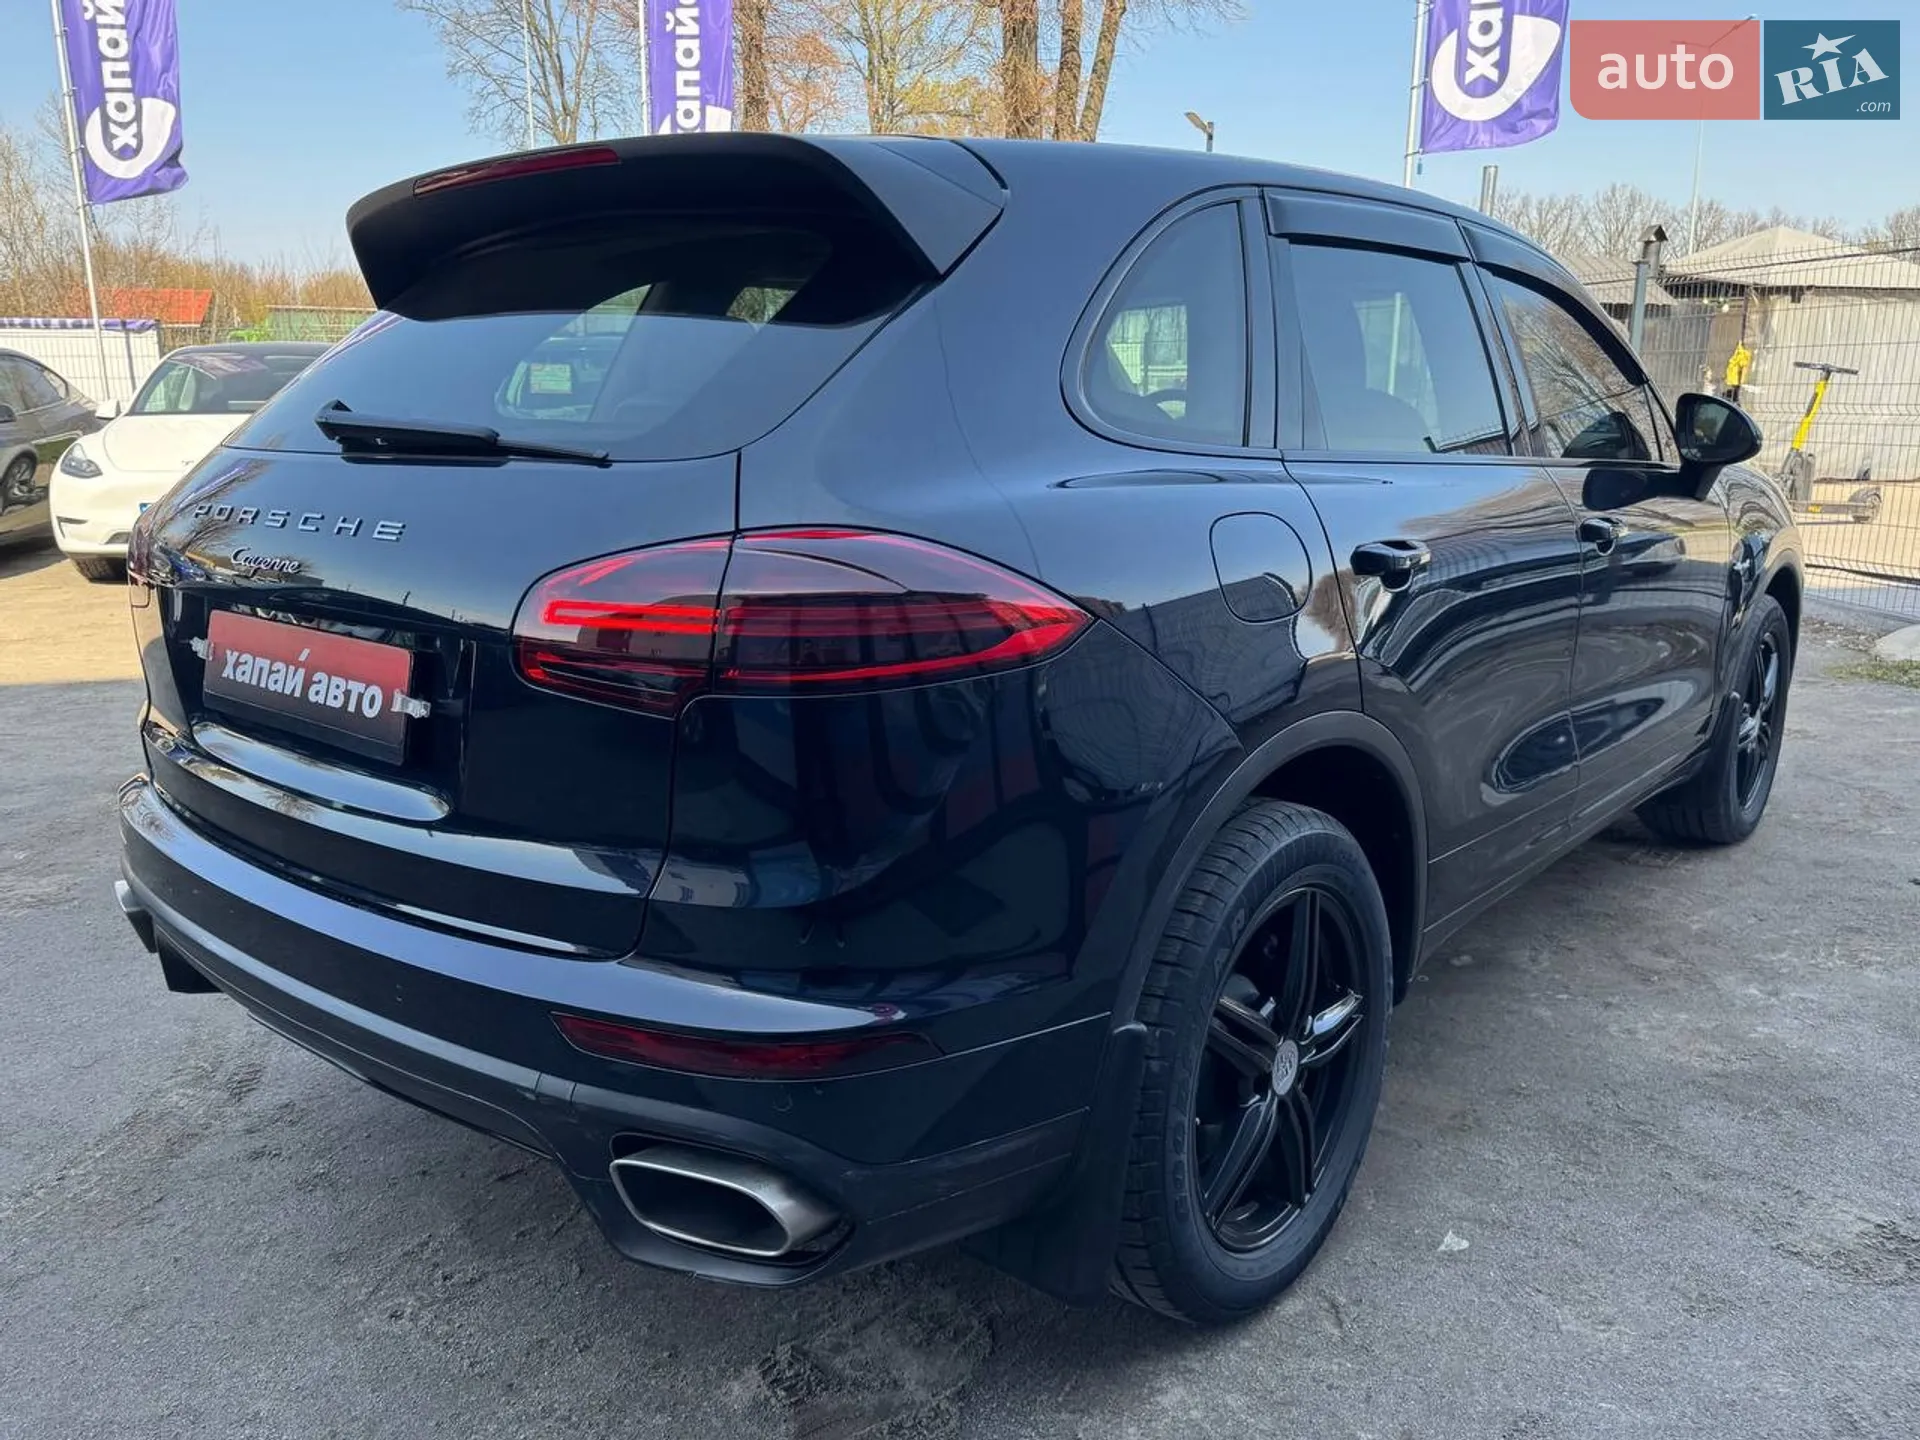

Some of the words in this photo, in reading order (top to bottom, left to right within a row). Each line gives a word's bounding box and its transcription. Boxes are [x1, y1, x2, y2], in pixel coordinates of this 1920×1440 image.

[665, 0, 701, 133] апай
[1465, 0, 1504, 85] ха
[194, 503, 406, 542] PORSCHE
[230, 546, 301, 578] Cayenne
[221, 648, 310, 698] хапай
[308, 671, 384, 719] авто
